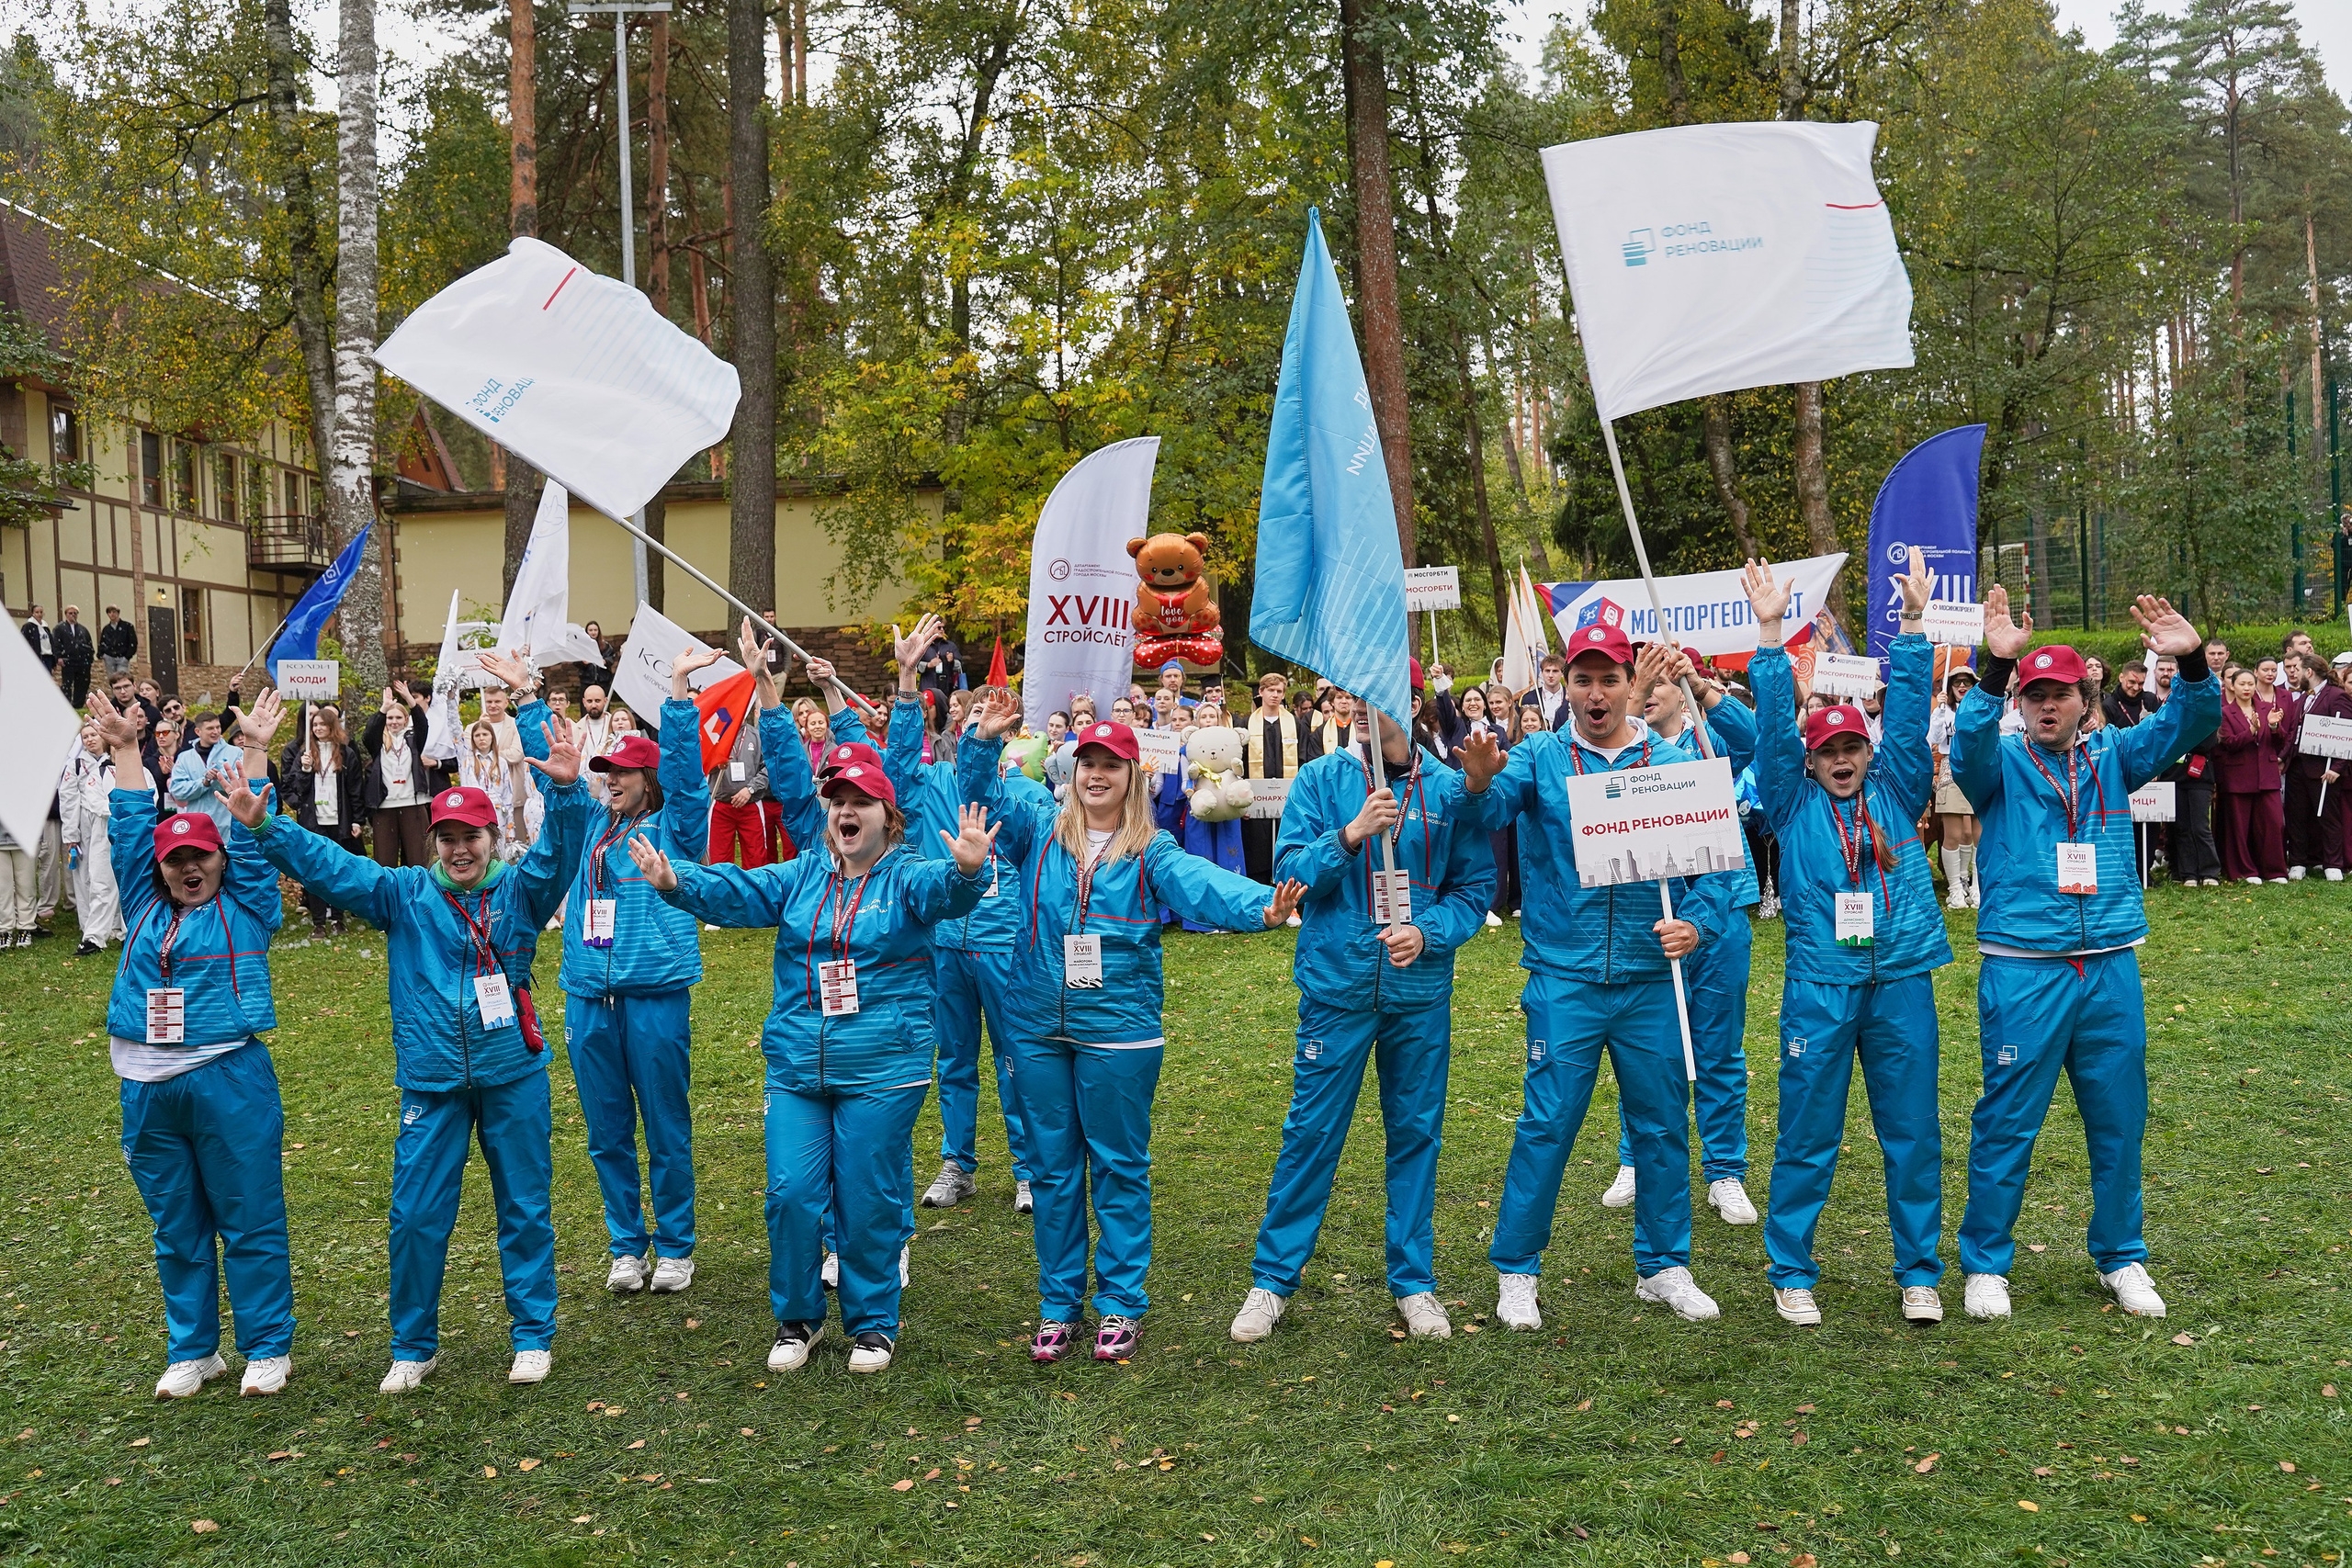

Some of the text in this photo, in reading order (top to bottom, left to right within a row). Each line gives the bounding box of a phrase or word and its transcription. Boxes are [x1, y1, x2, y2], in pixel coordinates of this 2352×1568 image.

[1660, 220, 1713, 239] ФОНД
[1665, 236, 1764, 259] РЕНОВАЦИИ
[472, 378, 503, 406] ФОНД
[492, 377, 535, 416] ЕНОВАЦ
[1406, 585, 1453, 593] МОСГОРБТИ
[1046, 595, 1130, 630] XVIII
[1160, 606, 1184, 616] love
[1631, 592, 1804, 635] МОСГОРГЕОТСТ
[1939, 605, 1975, 613] МОСИНЖПРОЕКТ
[1165, 617, 1186, 626] you
[1924, 618, 1982, 627] МОСИНЖПРОЕКТ
[1044, 626, 1127, 648] СТРОЙСЛЁТ
[290, 676, 327, 684] КОЛДИ
[1818, 670, 1873, 680] МОСГОРГЕОТРЕСТ
[2305, 731, 2352, 742] МОСМЕТРОСТР
[1139, 747, 1176, 756] АРХ-ПРОЕКТ
[1629, 773, 1662, 784] ФОНД
[1632, 780, 1696, 795] РЕНОВАЦИИ
[1581, 808, 1730, 837] ФОНД РЕНОВАЦИИ
[484, 985, 500, 994] XVIII
